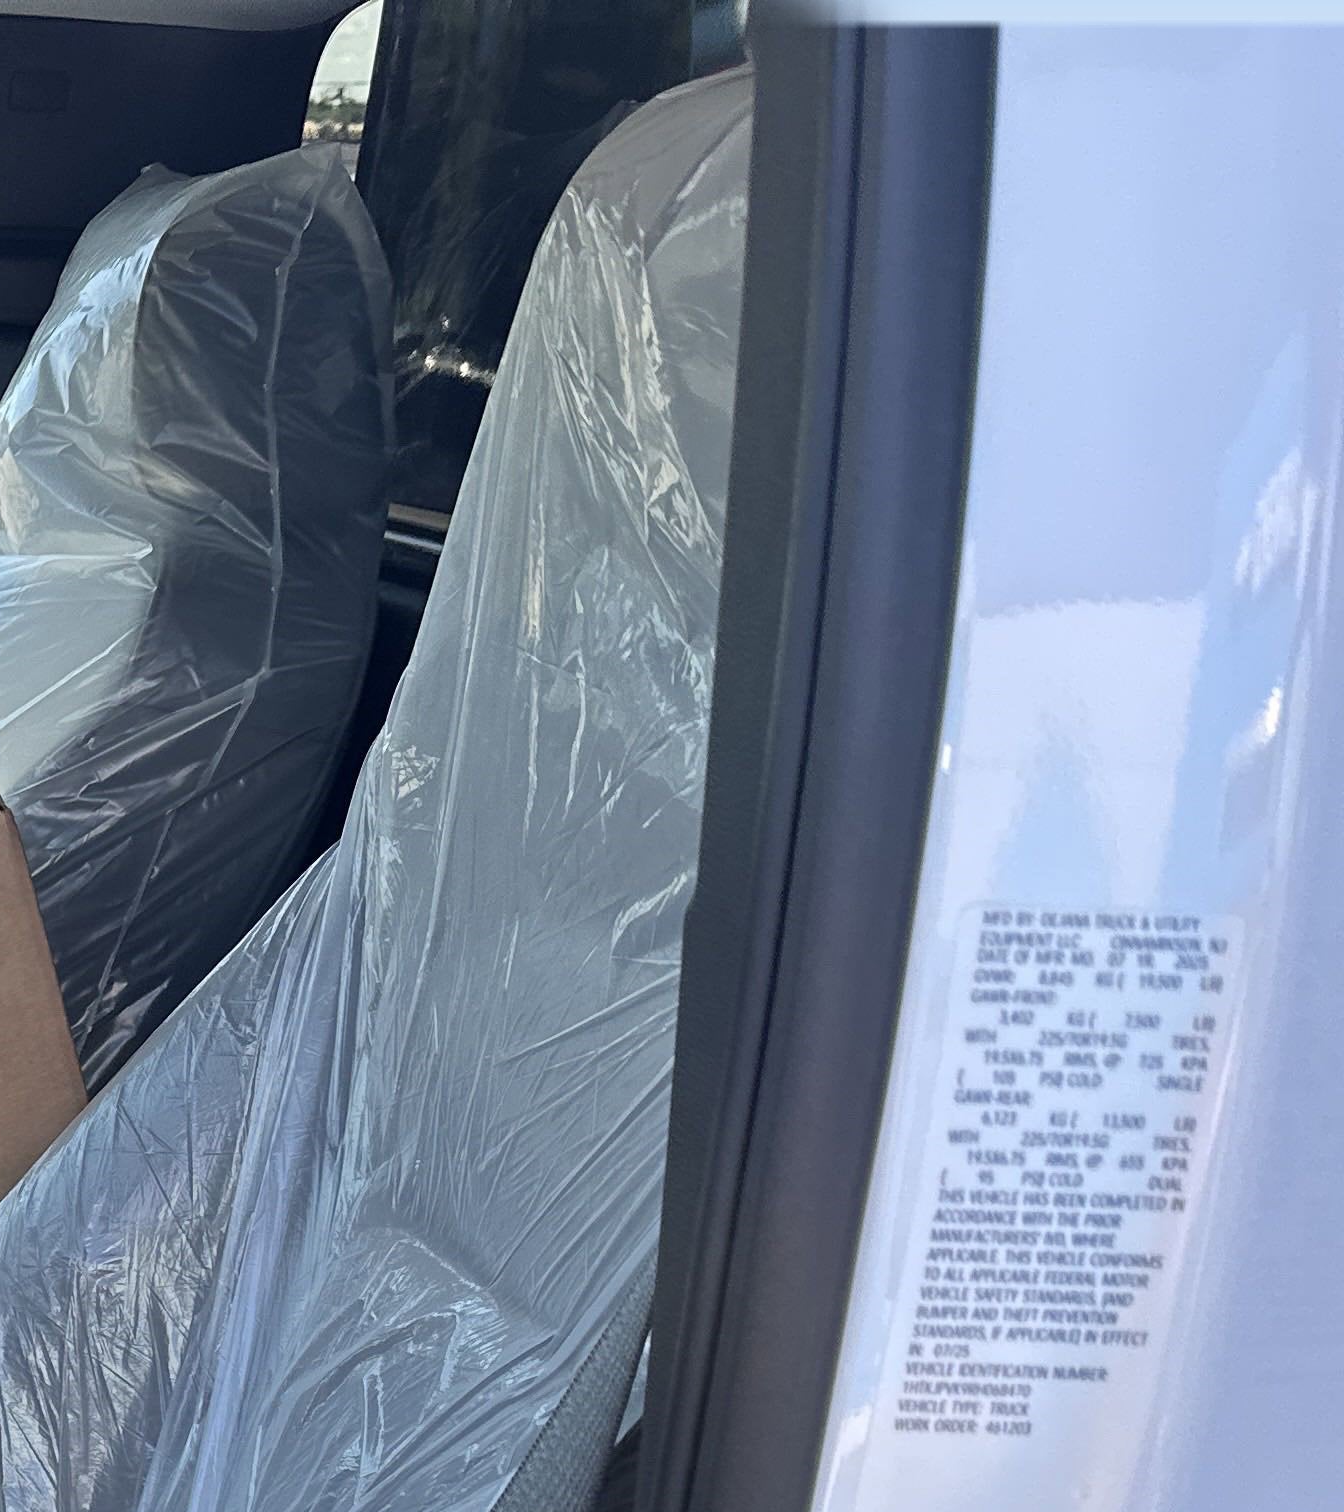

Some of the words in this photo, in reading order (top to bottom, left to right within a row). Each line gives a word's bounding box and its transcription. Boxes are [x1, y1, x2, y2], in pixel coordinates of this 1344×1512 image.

[938, 1188, 965, 1204] THIS
[969, 1189, 1019, 1205] VEHICLE
[1022, 1191, 1050, 1206] HAS
[1053, 1192, 1087, 1208] BEEN
[1089, 1193, 1168, 1210] COMPLETED
[932, 1208, 1016, 1225] ACCORDANCE
[1021, 1211, 1053, 1225] WITH
[1005, 1250, 1031, 1265] THIS
[1036, 1250, 1086, 1267] VEHICLE
[924, 1266, 941, 1280] TO
[943, 1267, 963, 1282] ALL
[969, 1268, 1040, 1284] APPLICABLE
[1044, 1270, 1095, 1286] FEDERAL
[920, 1286, 969, 1301] VEHICLE
[974, 1287, 1018, 1303] SAFETY
[916, 1306, 968, 1320] BUMPER
[972, 1308, 999, 1321] AND
[905, 1361, 953, 1377] VEHICLE
[958, 1363, 1048, 1379] IDENTIFICATION
[897, 1399, 946, 1414] VEHICLE
[990, 1401, 1031, 1416] TRUCK
[894, 1418, 930, 1432] WORK
